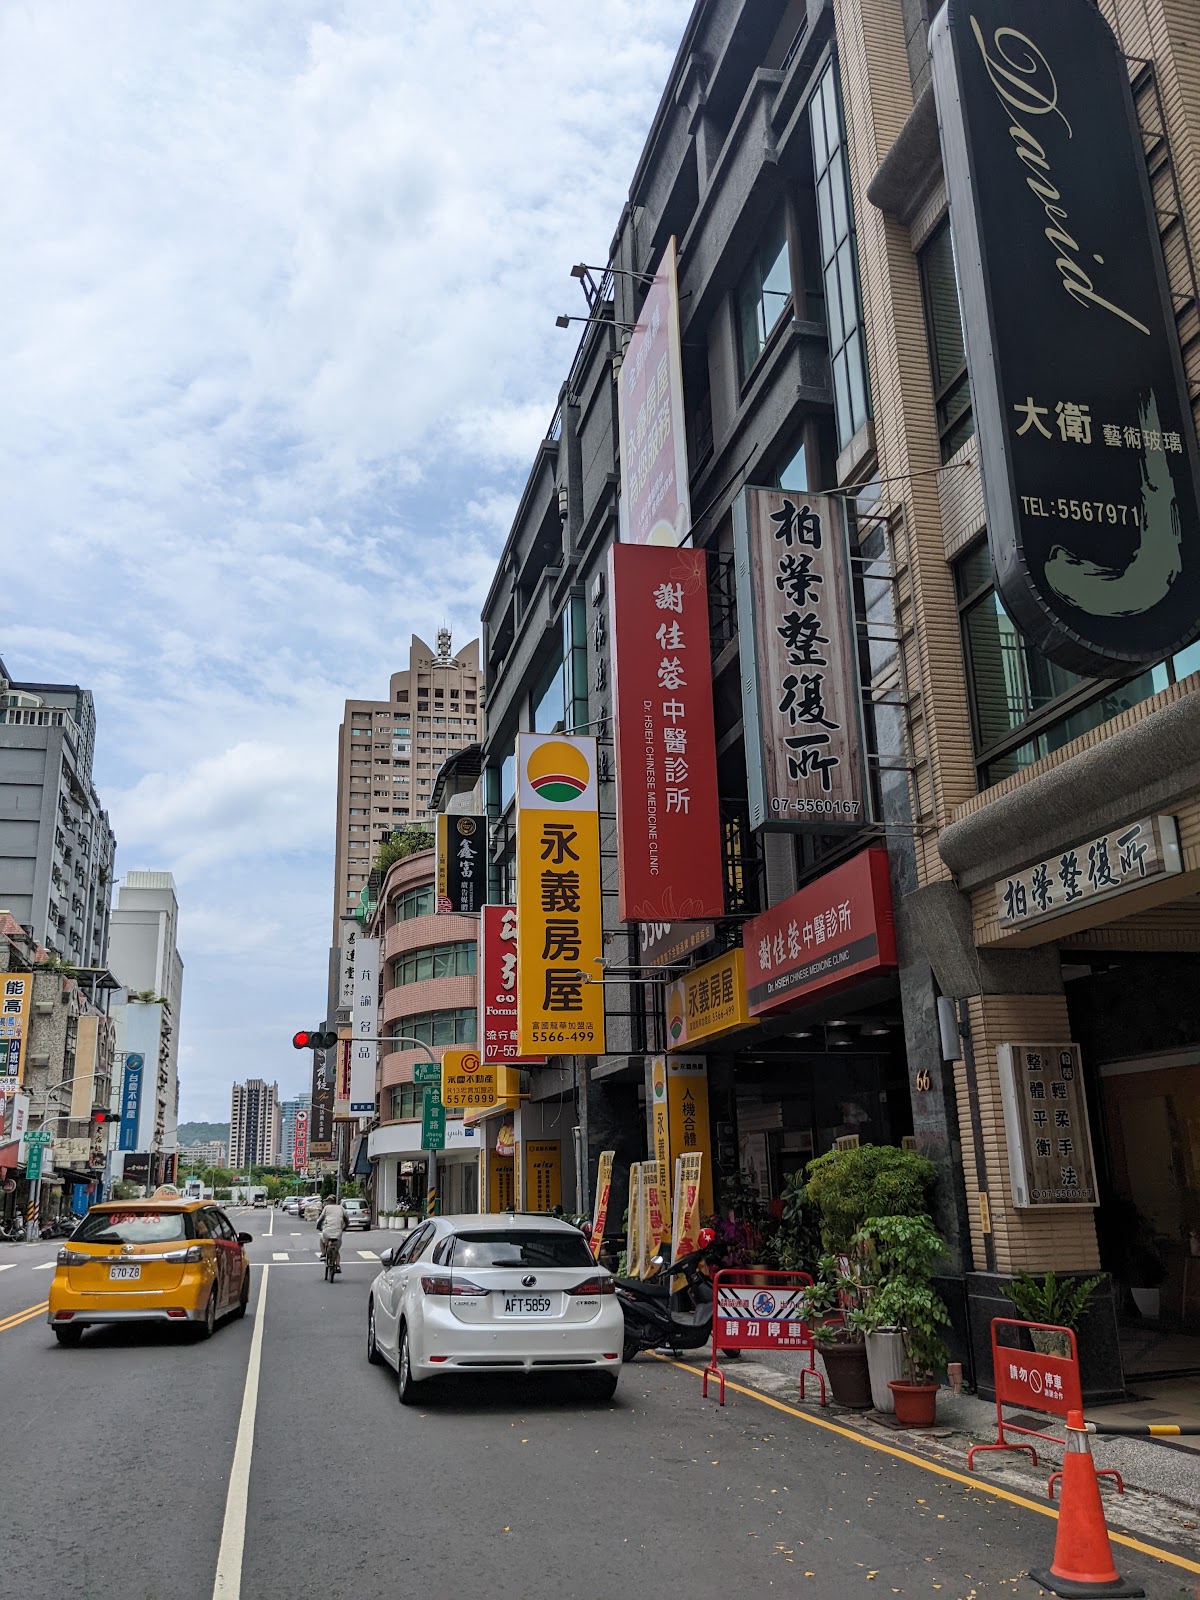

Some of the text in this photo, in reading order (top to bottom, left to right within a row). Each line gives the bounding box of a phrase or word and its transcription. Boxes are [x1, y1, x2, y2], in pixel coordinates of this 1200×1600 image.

[970, 15, 1150, 335] David
[627, 351, 669, 469] 永義房屋
[1013, 396, 1183, 453] 大衛 藝術玻璃
[629, 396, 671, 513] 為您服務
[1021, 495, 1139, 527] TEL:5567971
[643, 700, 659, 876] Dr. HSIEH CHINESE MEDICINE CLINIC
[771, 797, 860, 815] 07-5560167
[540, 823, 583, 1012] 永義房屋
[688, 966, 735, 1018] 永義房屋
[774, 975, 790, 991] HSIEH
[789, 969, 809, 987] CHINESE
[809, 959, 833, 979] MEDICINE
[832, 949, 850, 968] CLINIC
[532, 1032, 594, 1042] 5566-499
[447, 1094, 494, 1104] 5576999
[916, 1069, 930, 1092] 66
[1026, 1053, 1051, 1157] 整體平衡
[682, 1088, 697, 1147] 人機合體
[1051, 1082, 1077, 1186] 輕柔手法
[110, 1267, 140, 1279] 670-Z8
[726, 1321, 801, 1337] 請勿停車
[1009, 1364, 1063, 1391] 請勿 停車
